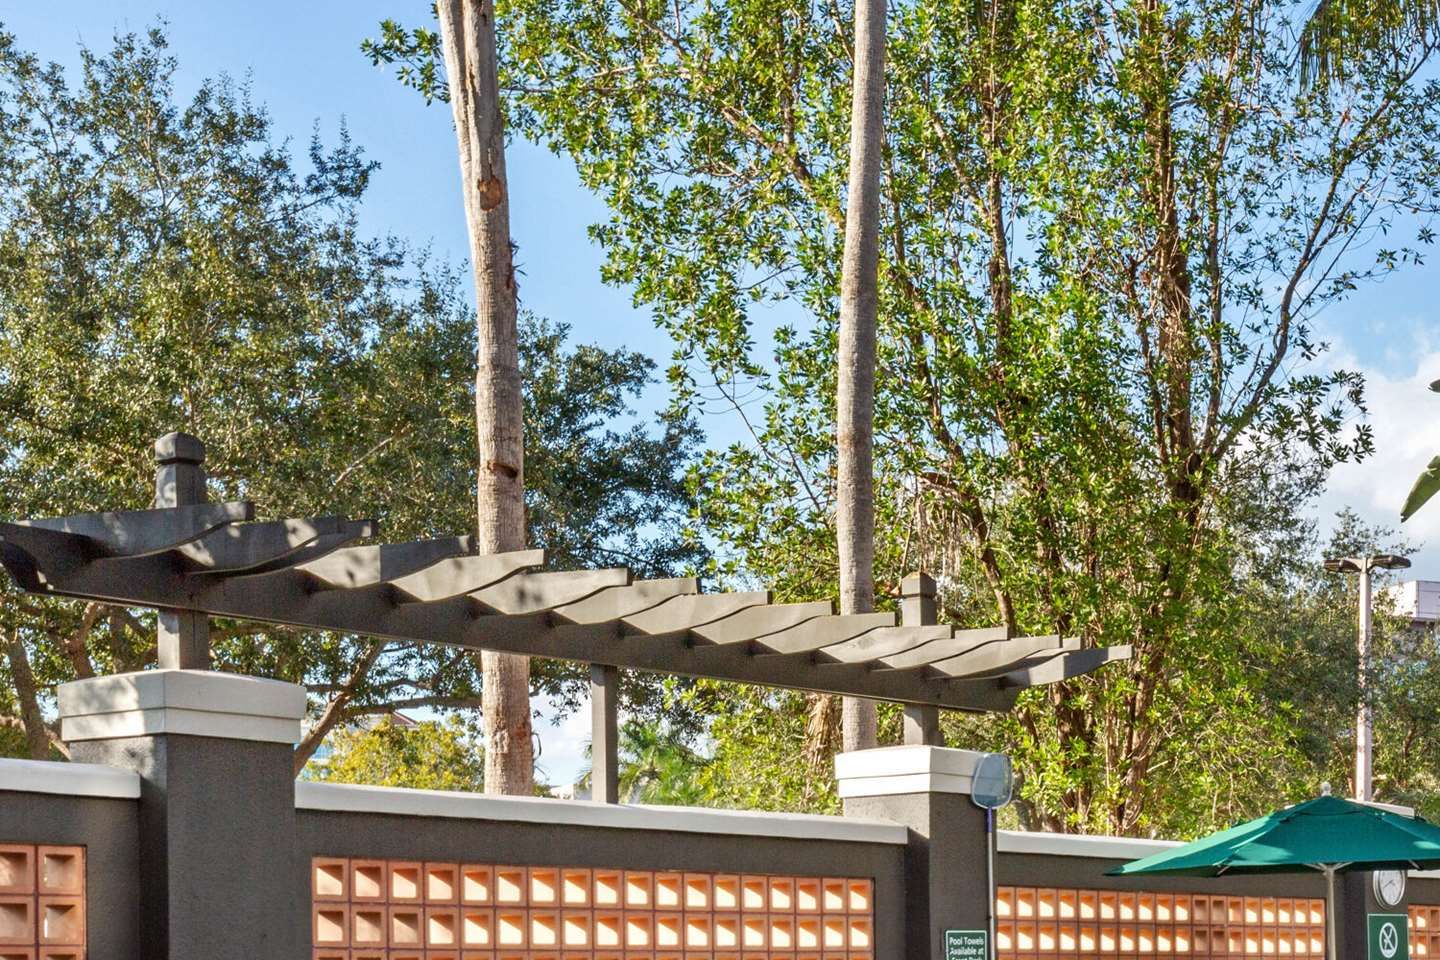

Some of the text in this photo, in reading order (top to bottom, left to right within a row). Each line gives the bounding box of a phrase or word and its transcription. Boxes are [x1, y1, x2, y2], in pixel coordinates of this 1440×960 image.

[949, 936, 984, 945] Pool Towels
[950, 947, 984, 955] Available at
